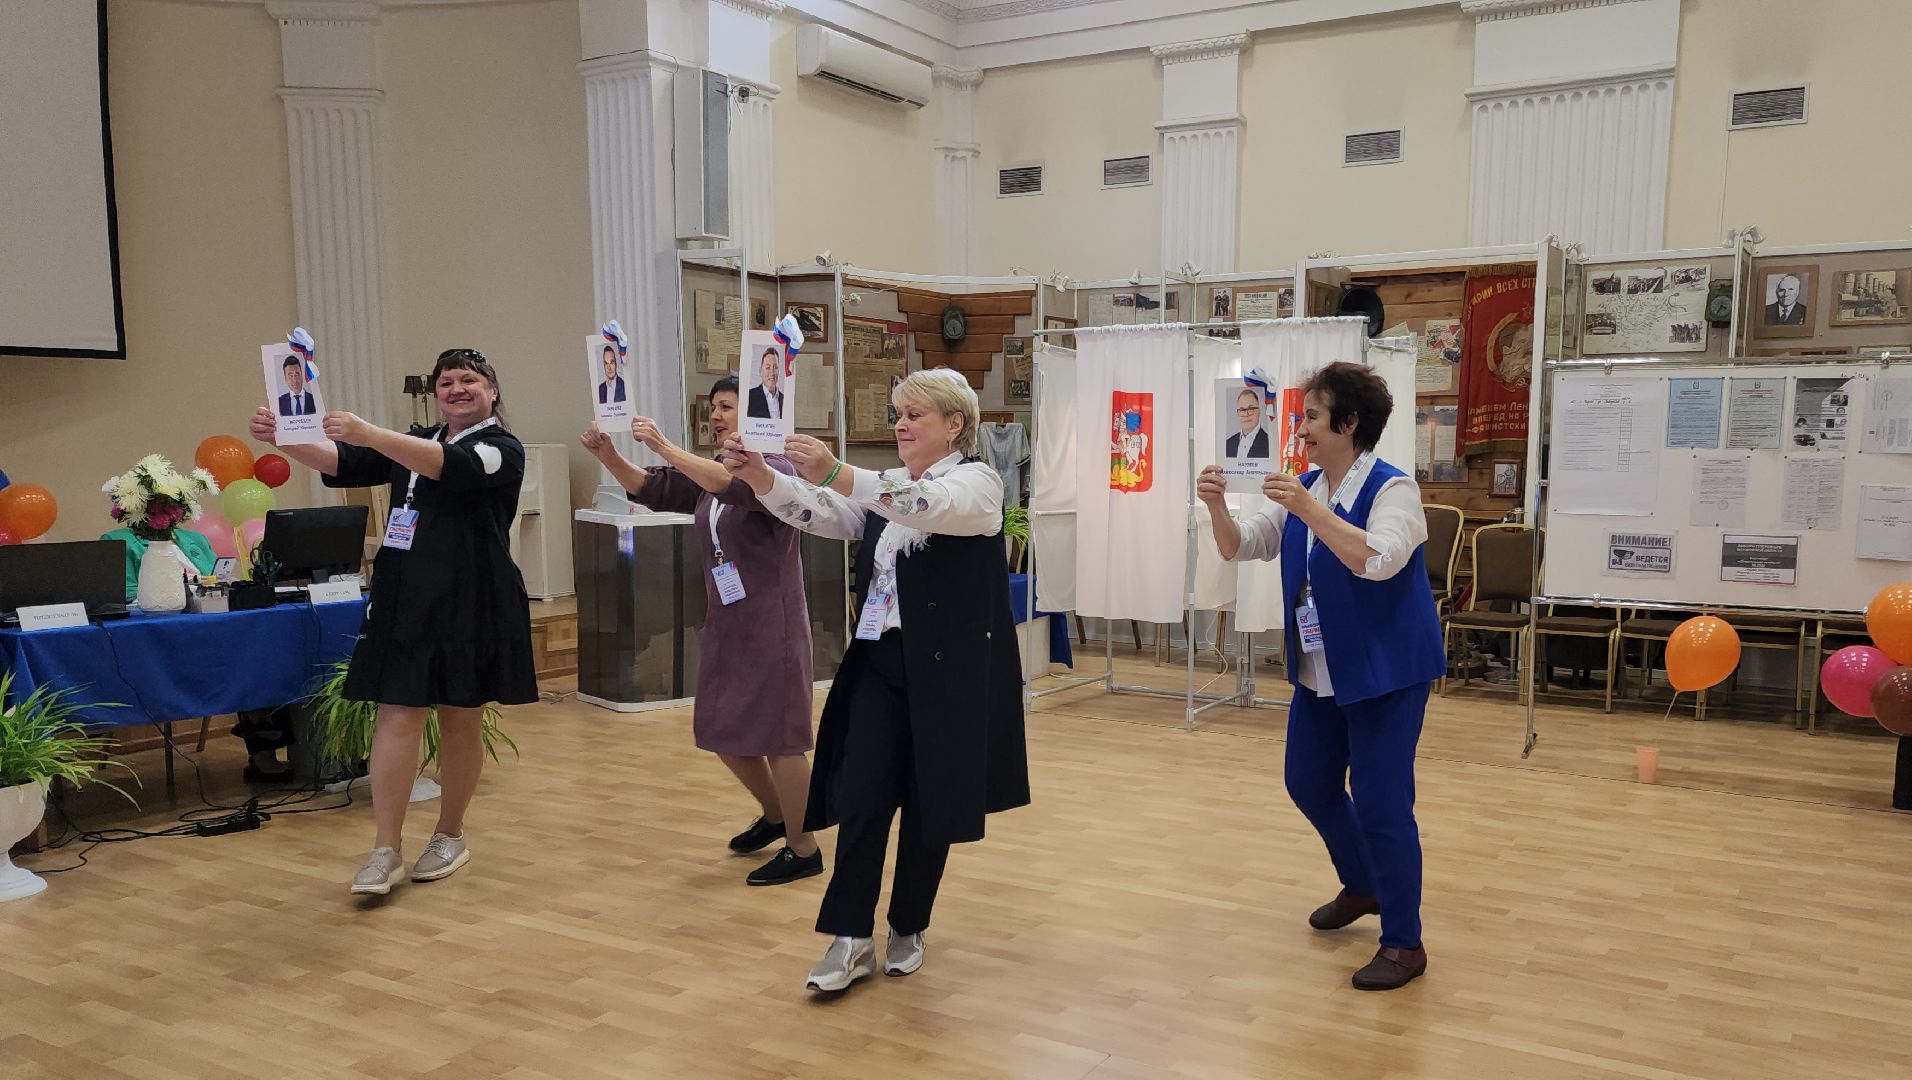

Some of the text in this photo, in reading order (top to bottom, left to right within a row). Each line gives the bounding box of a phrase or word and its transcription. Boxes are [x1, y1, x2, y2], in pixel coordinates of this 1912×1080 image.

[1496, 278, 1518, 293] ВСЕХ
[1510, 402, 1529, 411] ЛЕН
[1610, 534, 1672, 547] ВНИМАНИЕ!
[1635, 555, 1669, 564] ВЕДЕТСЯ
